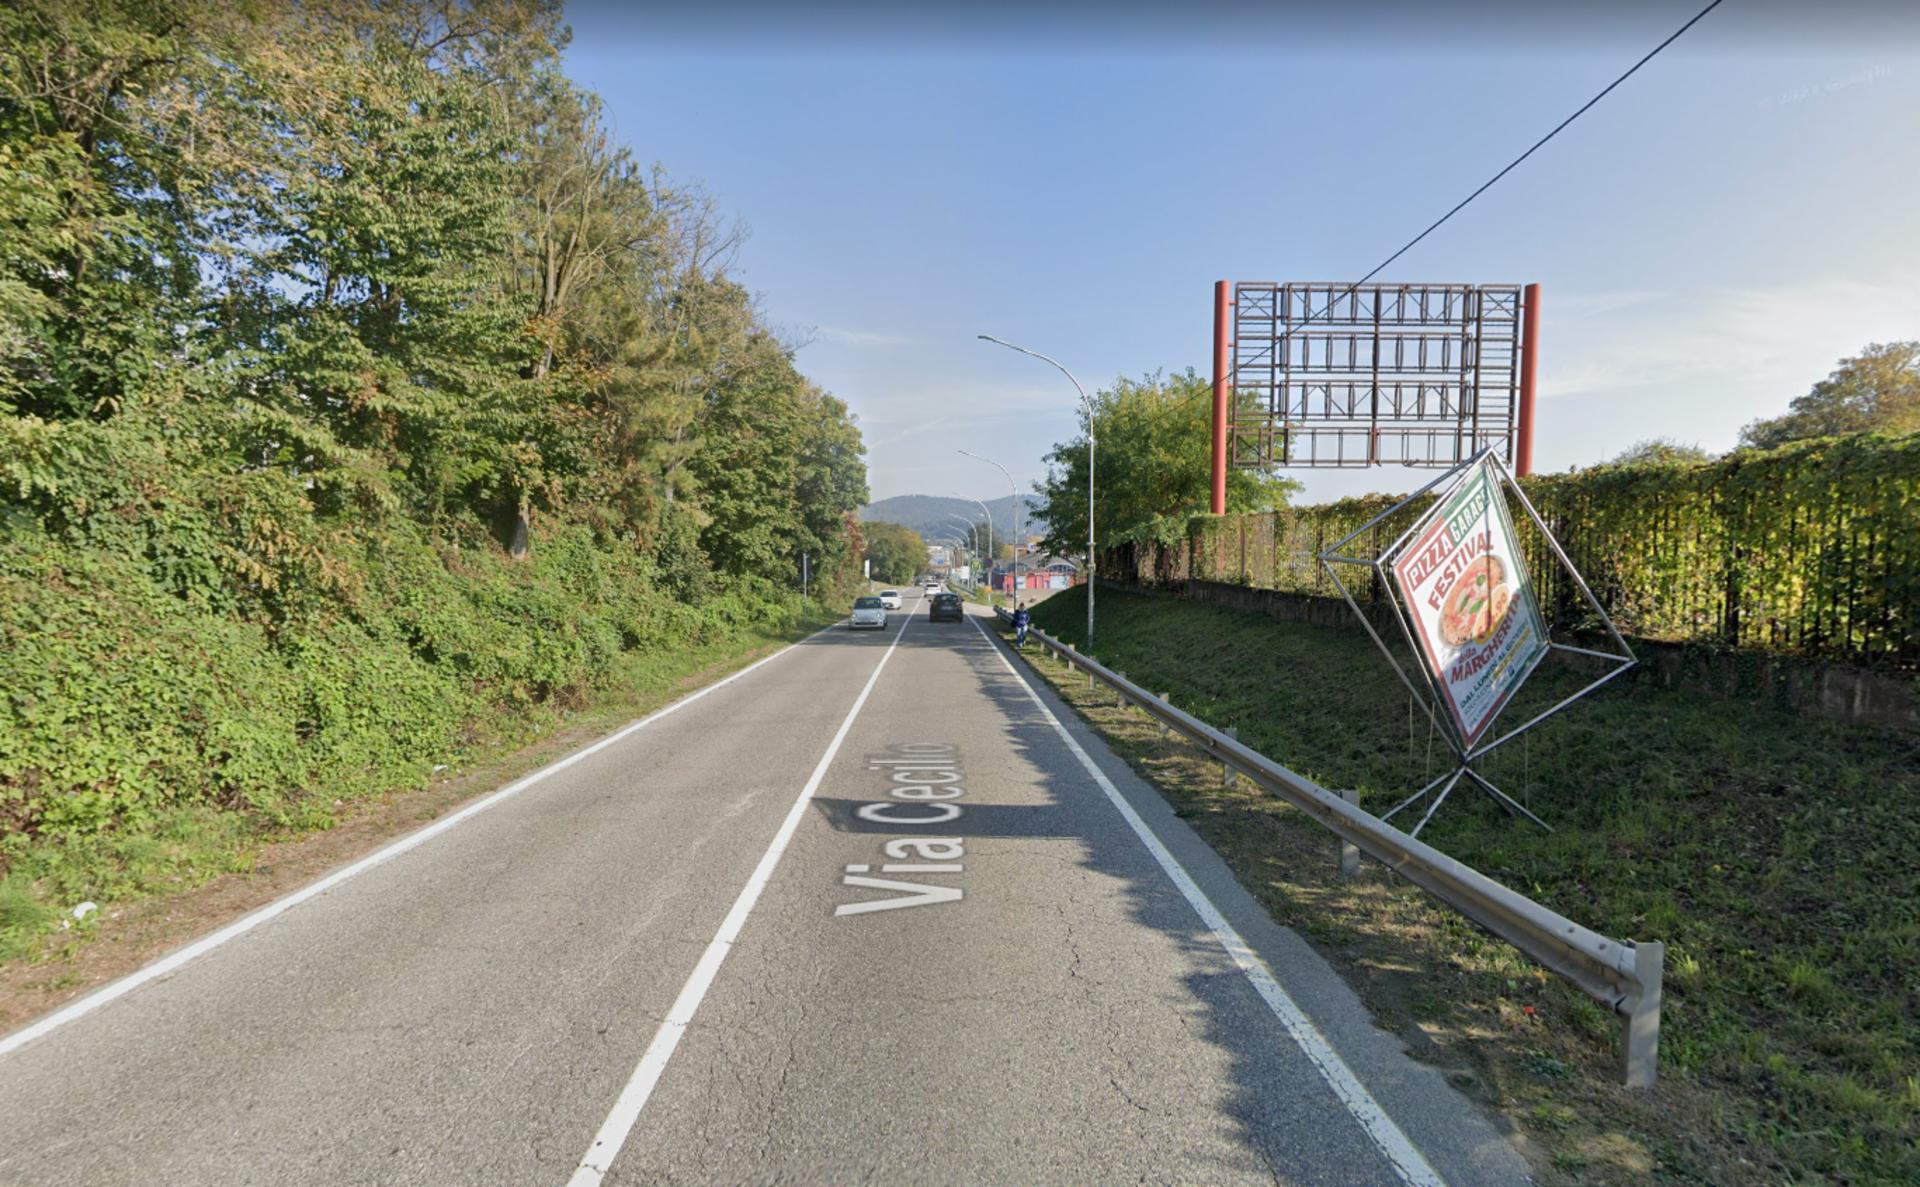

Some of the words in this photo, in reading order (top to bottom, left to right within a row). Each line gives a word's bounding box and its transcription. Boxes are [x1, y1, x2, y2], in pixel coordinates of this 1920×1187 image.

[1410, 536, 1454, 586] PIZZA
[1450, 488, 1490, 541] GARAGE
[1428, 530, 1495, 611] FESTIVAL
